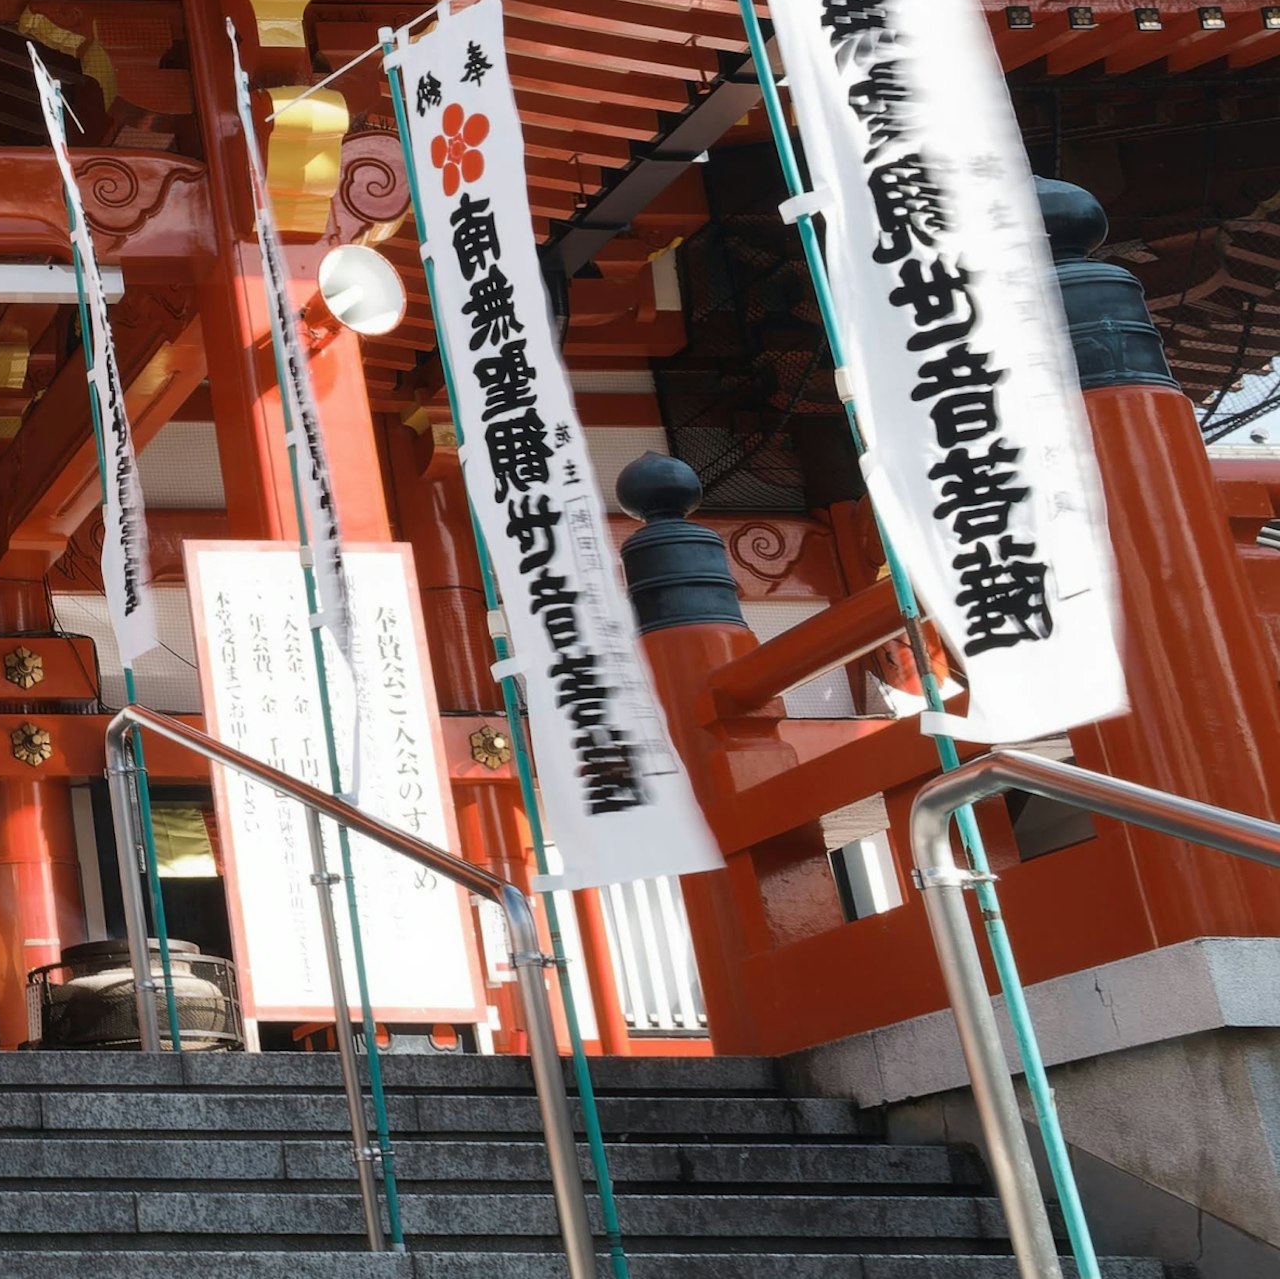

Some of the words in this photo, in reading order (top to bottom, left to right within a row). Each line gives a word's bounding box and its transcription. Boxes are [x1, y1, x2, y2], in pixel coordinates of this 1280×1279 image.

[374, 607, 438, 891] 奉賛会ご入会のすめ
